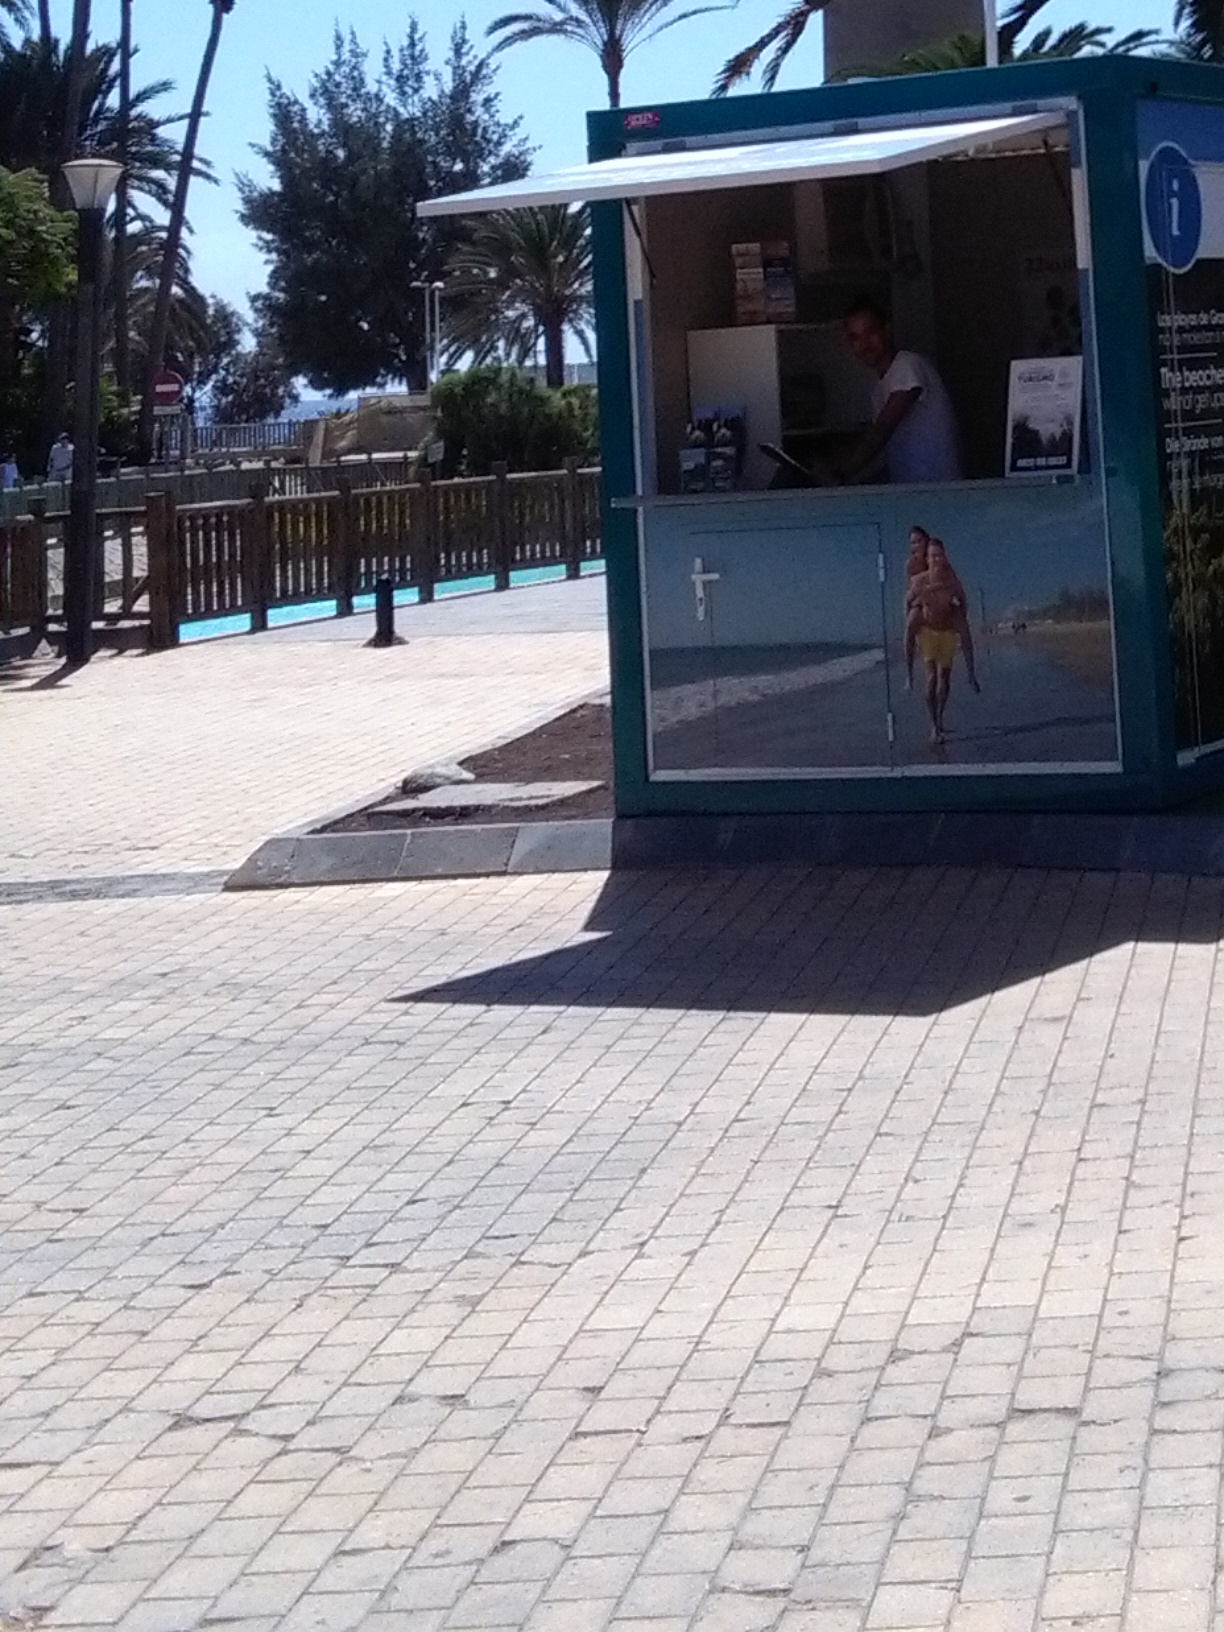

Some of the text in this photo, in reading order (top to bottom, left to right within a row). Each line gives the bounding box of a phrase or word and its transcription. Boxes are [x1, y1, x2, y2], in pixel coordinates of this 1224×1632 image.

[1199, 310, 1209, 325] de
[1160, 367, 1182, 388] The
[1179, 390, 1193, 410] not
[1194, 388, 1211, 414] get
